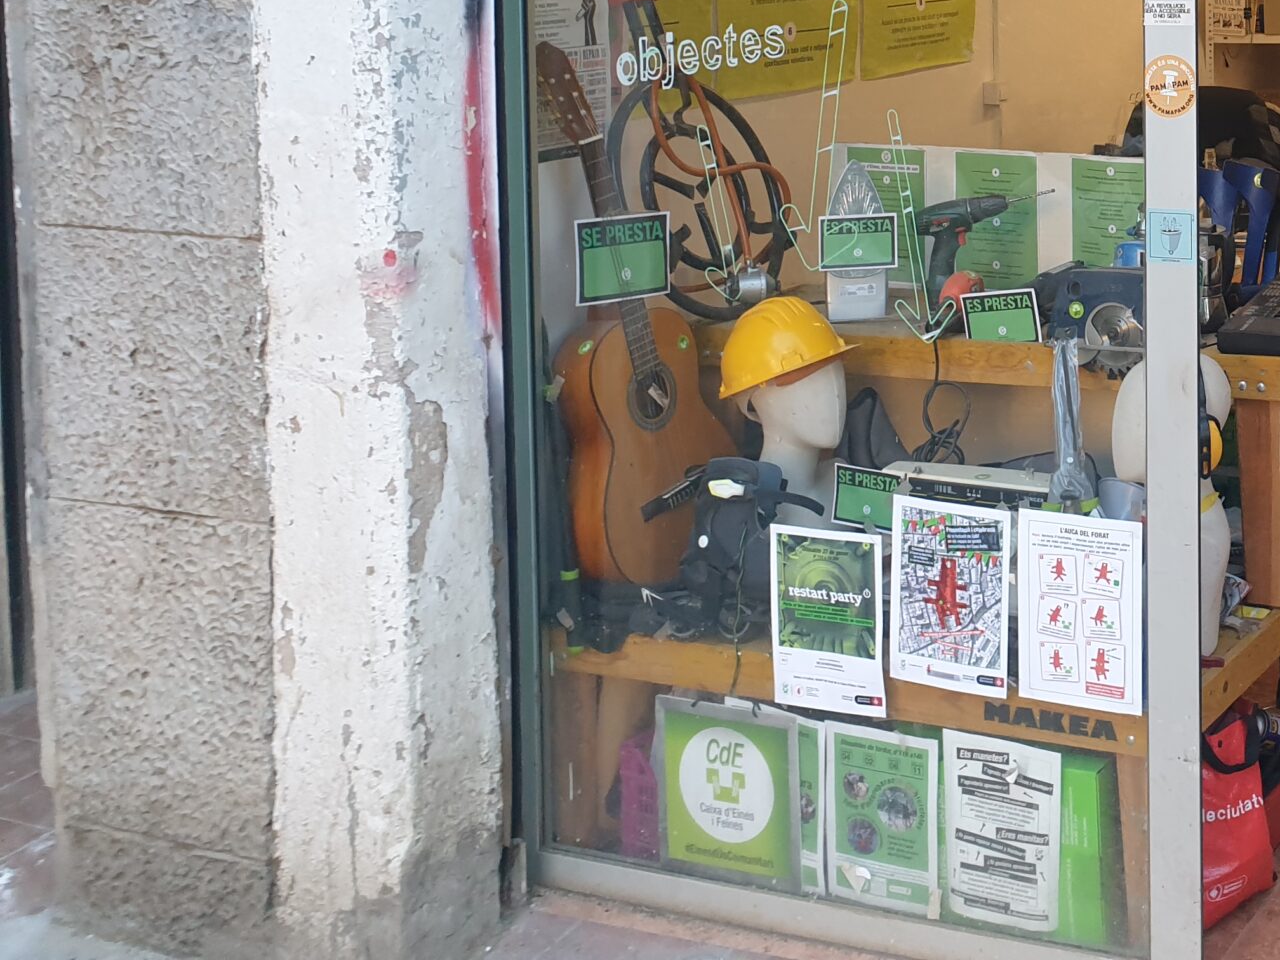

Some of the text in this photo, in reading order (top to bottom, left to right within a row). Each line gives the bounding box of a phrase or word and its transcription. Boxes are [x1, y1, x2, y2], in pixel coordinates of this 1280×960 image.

[615, 23, 786, 90] objectes
[582, 221, 664, 248] SE PRESTA
[842, 219, 892, 234] PRESTA
[966, 295, 1032, 313] ES PRESTA
[838, 470, 899, 492] SE PRESTA
[1060, 527, 1078, 535] L'AUCA
[788, 586, 863, 607] restart party
[984, 700, 1118, 742] MAKEA
[706, 738, 744, 768] CdE
[700, 802, 754, 822] Caixa d'Eines
[716, 817, 744, 831] Feines
